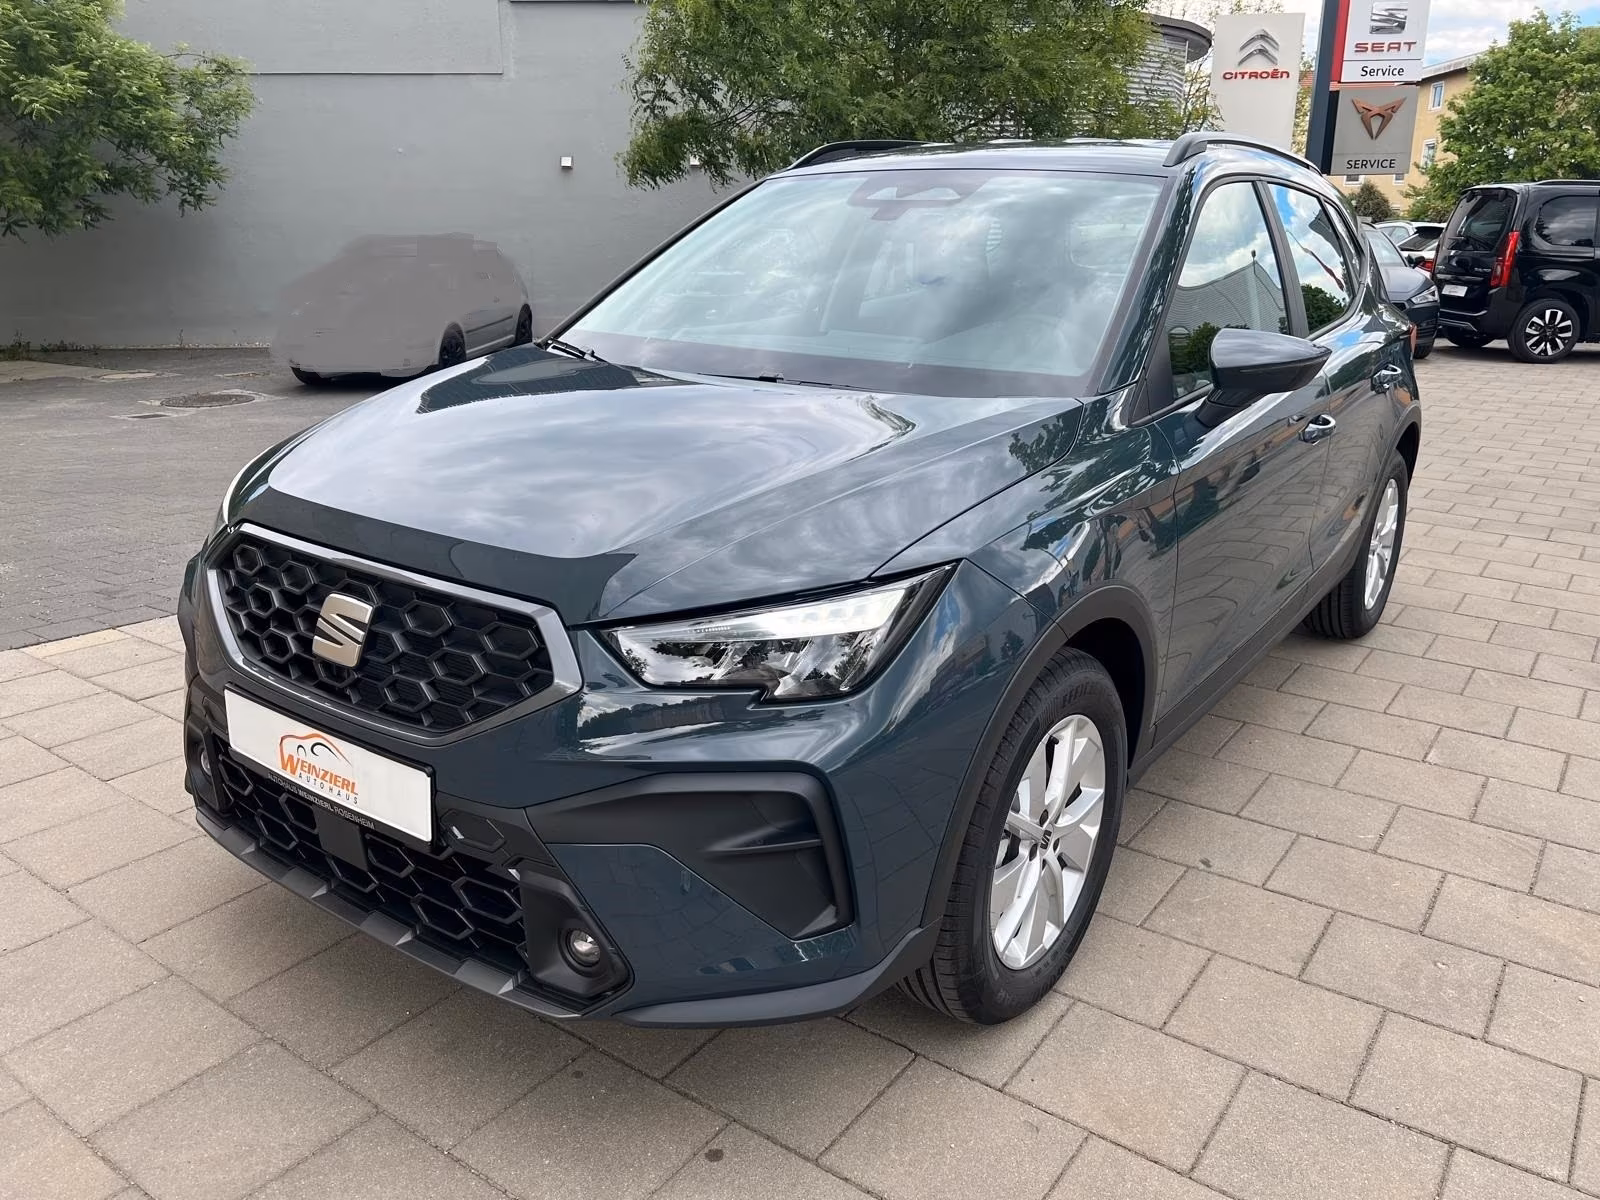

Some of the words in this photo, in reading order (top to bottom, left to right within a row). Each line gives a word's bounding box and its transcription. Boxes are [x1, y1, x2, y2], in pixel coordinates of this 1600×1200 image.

[1354, 41, 1417, 53] SEAT
[1222, 69, 1290, 81] CITROËN
[1360, 66, 1405, 77] Service
[1346, 159, 1396, 169] SERVICE
[280, 753, 359, 796] WEINZIERL
[298, 772, 359, 805] AUTOHAUS
[267, 772, 299, 794] AUTOHAUS
[298, 788, 335, 812] WEINZIERL
[334, 806, 376, 830] ROSENHEIM
